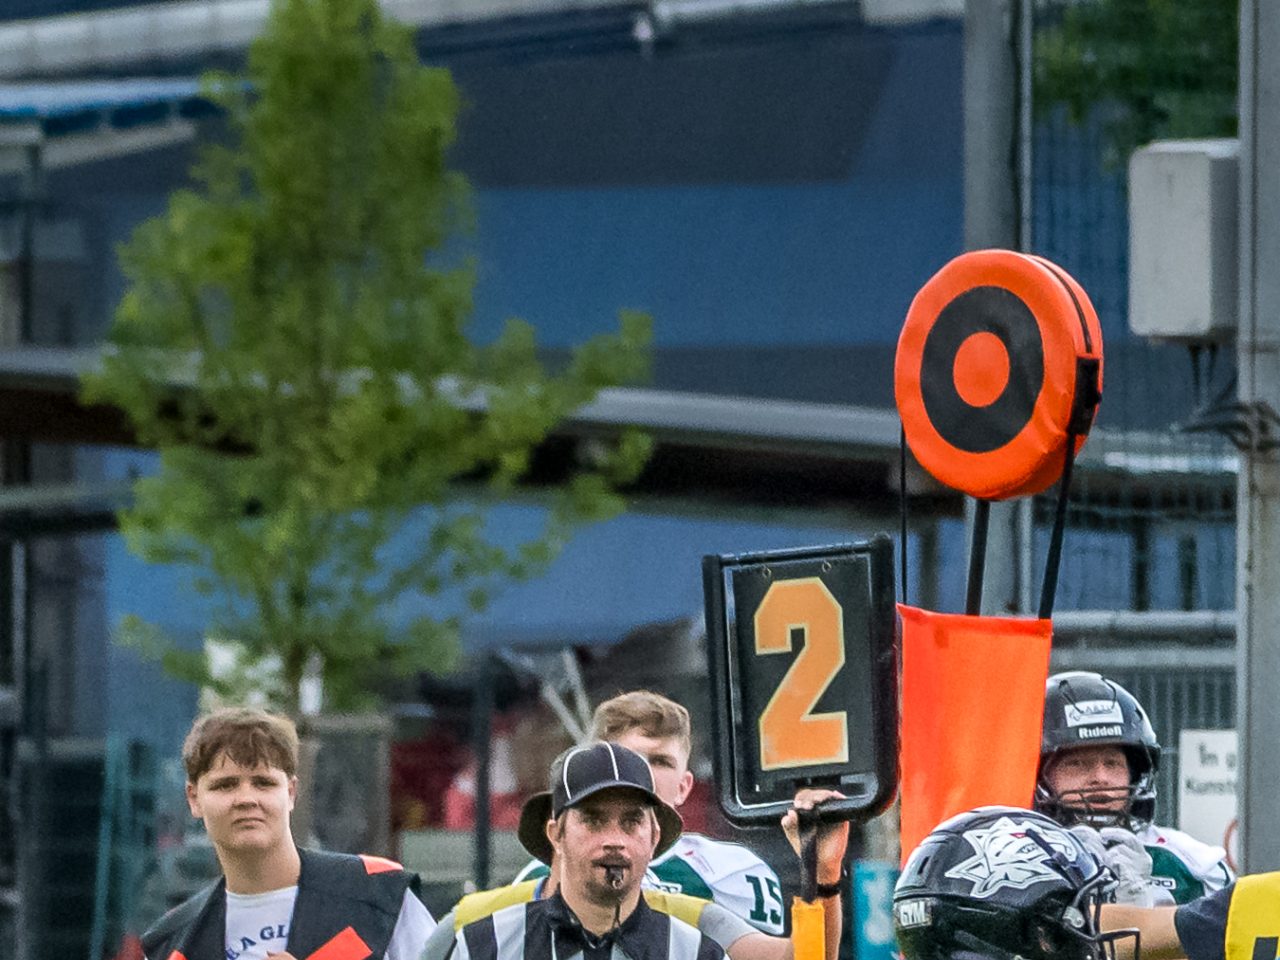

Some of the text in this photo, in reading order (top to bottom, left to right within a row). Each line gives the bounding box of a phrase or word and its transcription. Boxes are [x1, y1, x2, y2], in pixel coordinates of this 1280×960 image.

[754, 577, 849, 771] 2
[1078, 725, 1123, 739] Riddell
[744, 874, 782, 925] 15
[901, 902, 926, 926] GYM
